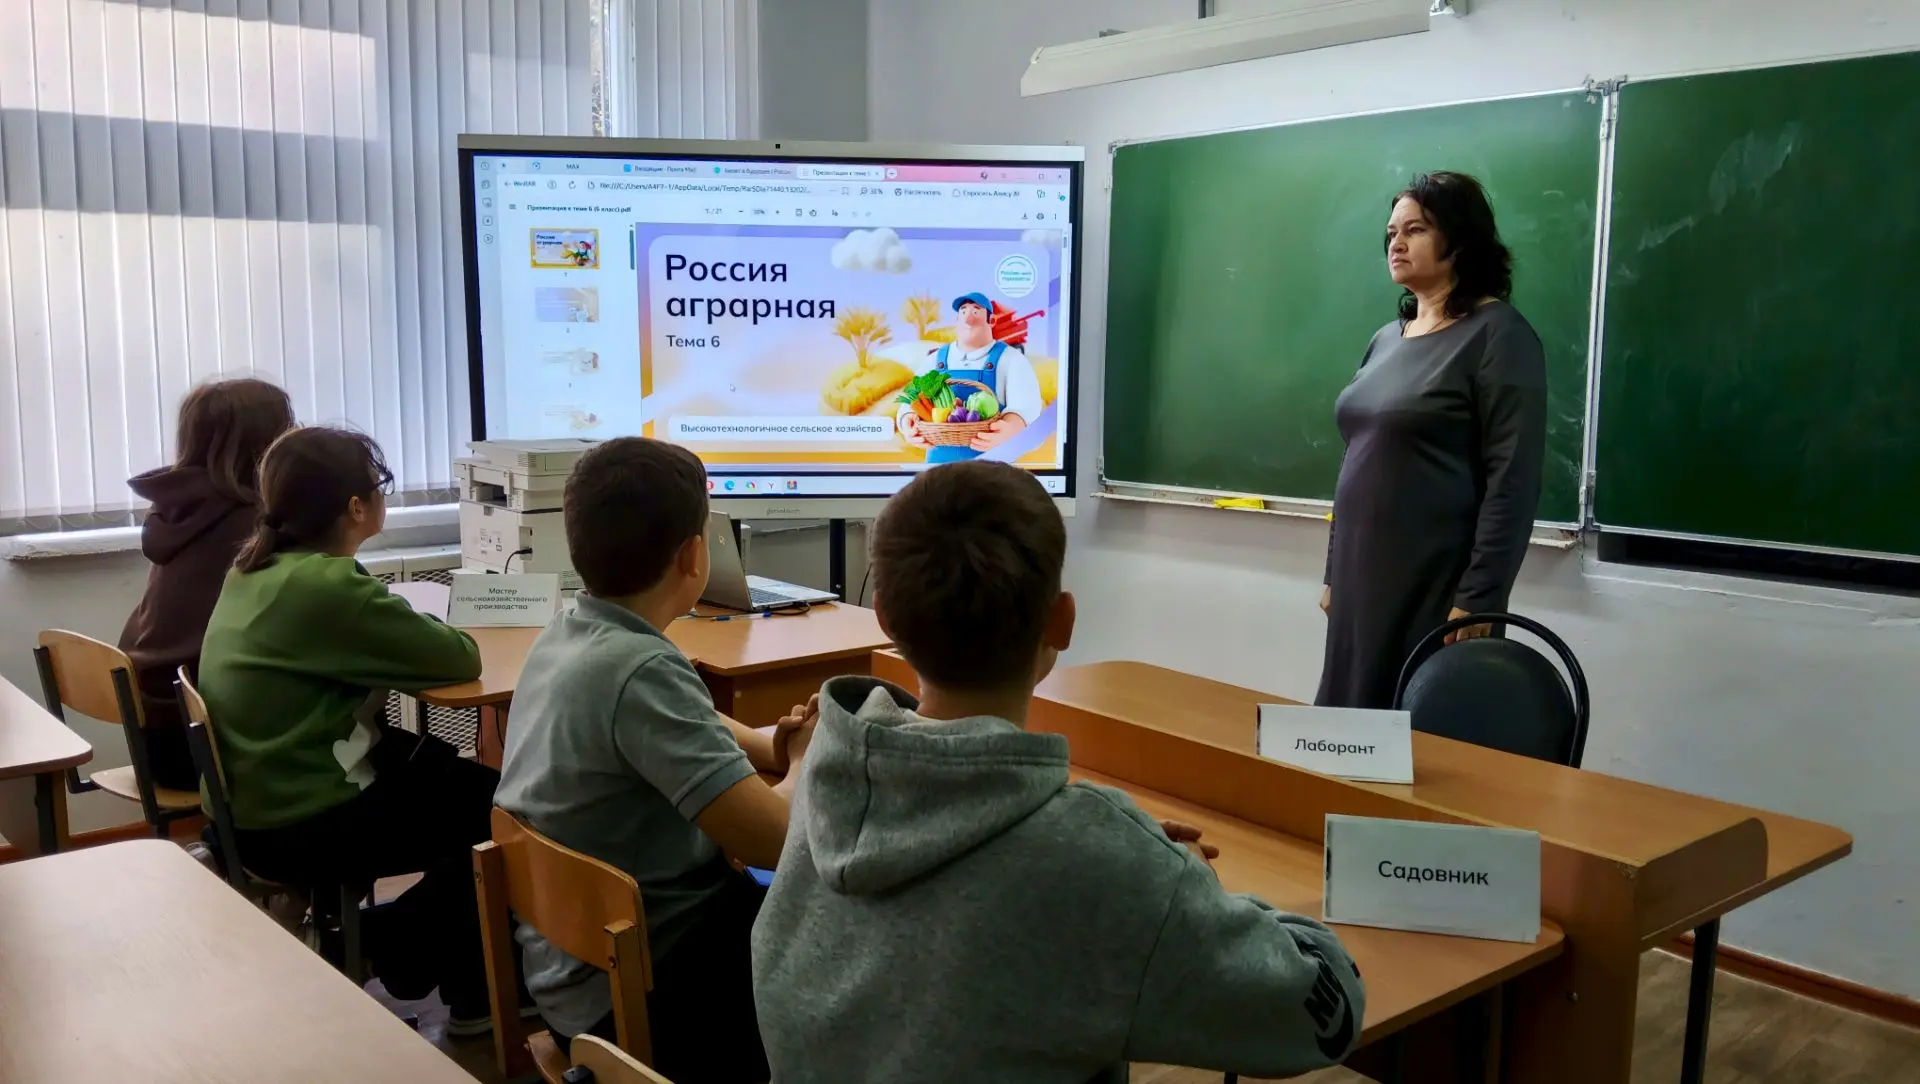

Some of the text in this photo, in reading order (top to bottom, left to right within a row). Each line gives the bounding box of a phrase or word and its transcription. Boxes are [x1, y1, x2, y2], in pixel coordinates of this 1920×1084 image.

[665, 253, 787, 283] Россия
[666, 296, 836, 326] аграрная
[665, 334, 721, 348] Тема 6
[680, 423, 883, 434] Высокотехнологичное сельское хозяйство
[488, 587, 517, 596] Мастер
[473, 603, 528, 611] производства
[1294, 738, 1376, 756] Лаборант
[1377, 860, 1490, 886] Садовник
